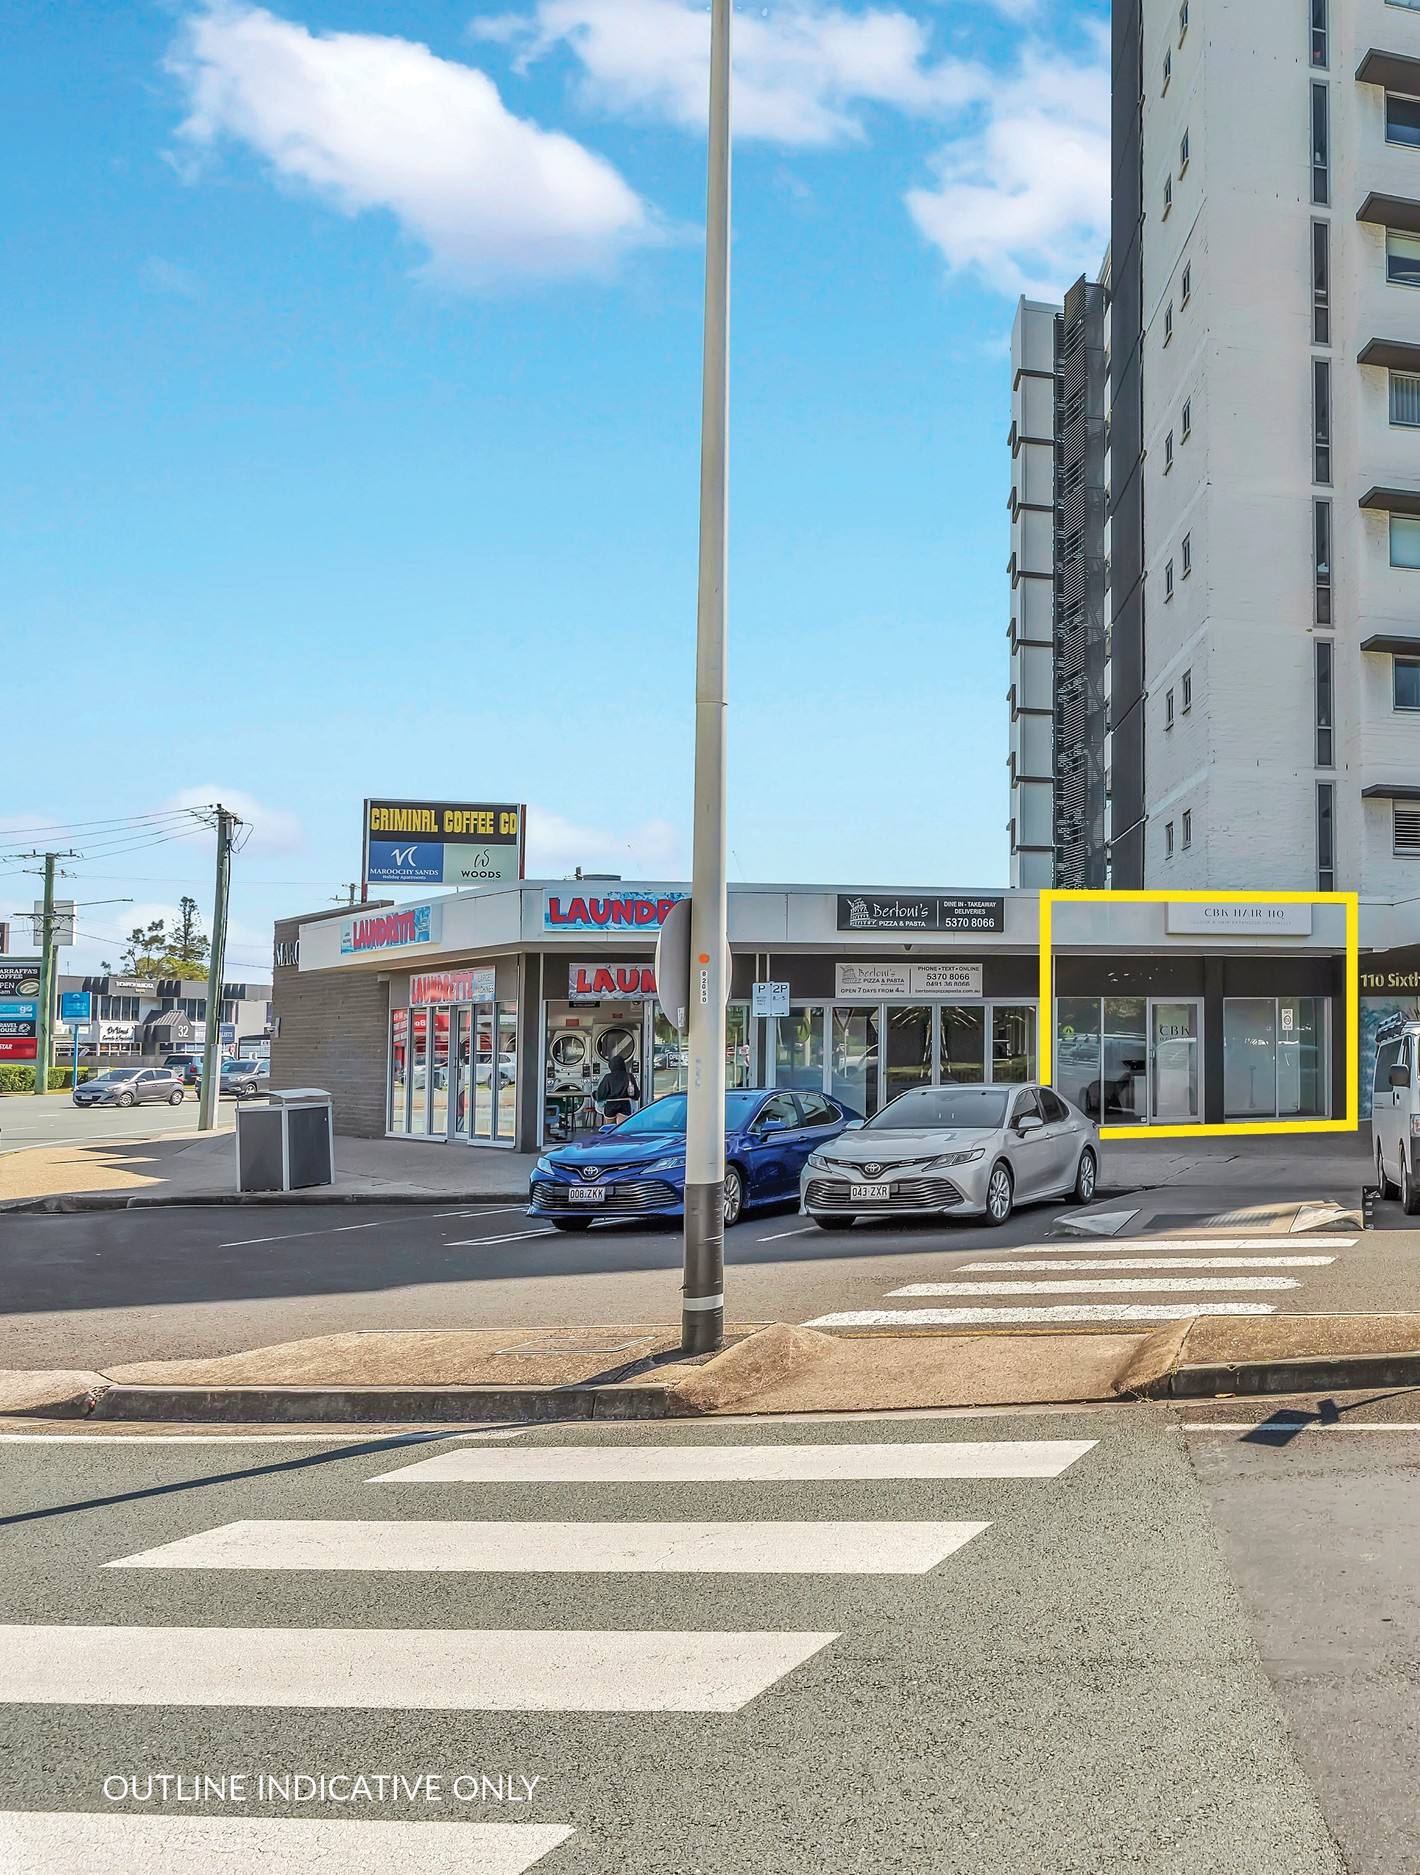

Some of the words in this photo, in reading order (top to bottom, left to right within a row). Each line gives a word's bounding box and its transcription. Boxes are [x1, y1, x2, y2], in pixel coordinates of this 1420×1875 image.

[371, 808, 438, 832] CRIMINAL
[444, 810, 494, 834] COFFEE
[500, 812, 517, 835] CO
[873, 901, 929, 918] Bertoni's
[1204, 908, 1229, 917] CBK
[1234, 909, 1262, 917] HAIR
[1268, 909, 1285, 919] HQ
[945, 918, 969, 927] 5370
[971, 918, 995, 928] 8066
[858, 967, 895, 977] Bertoni's
[1360, 973, 1384, 987] 110
[758, 985, 766, 993] P
[772, 985, 788, 993] 2P
[178, 1025, 189, 1038] 32
[1159, 1024, 1190, 1036] CBK
